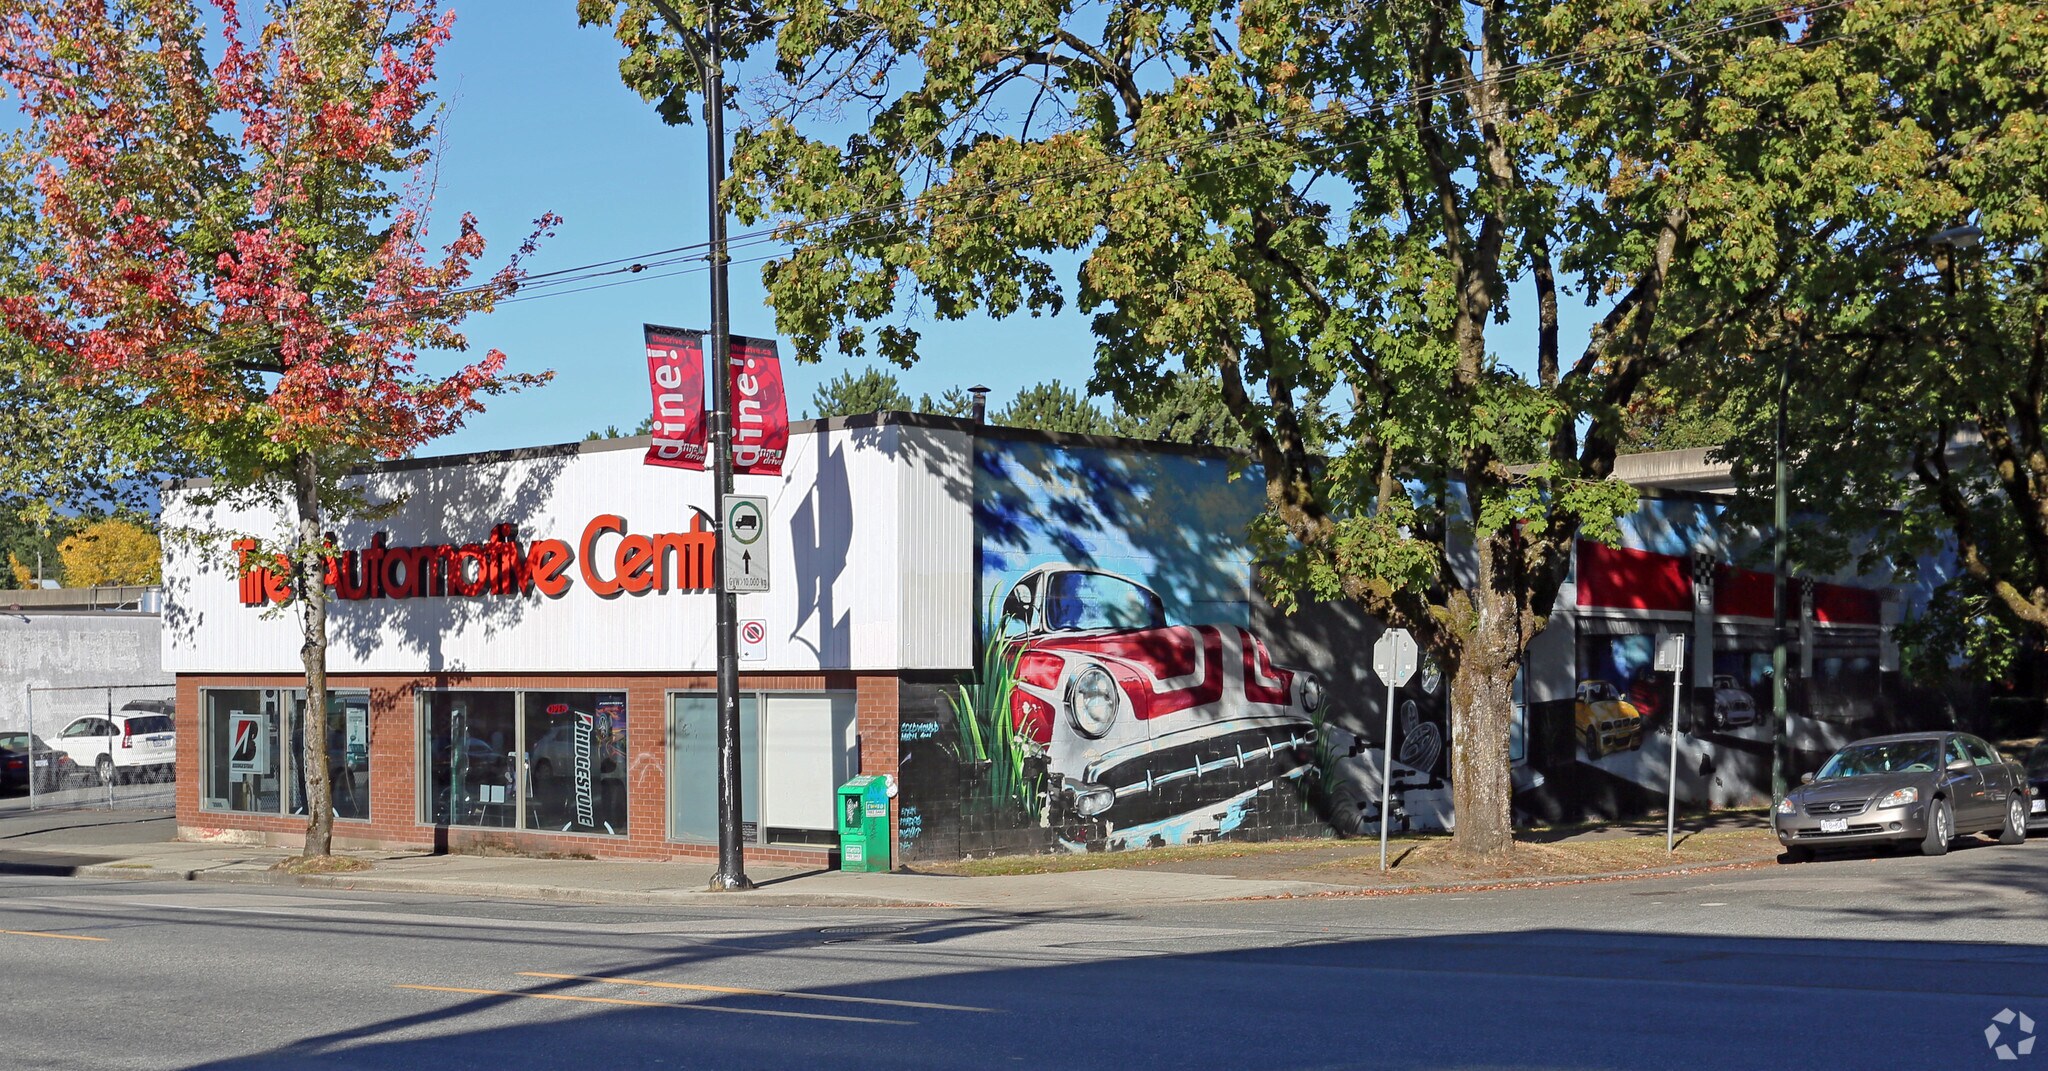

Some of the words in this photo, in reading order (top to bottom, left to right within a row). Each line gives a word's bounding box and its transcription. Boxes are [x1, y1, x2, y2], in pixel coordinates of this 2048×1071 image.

[652, 334, 695, 347] thedrive.ca
[648, 348, 686, 460] dine!
[730, 356, 763, 467] dine!
[321, 522, 574, 600] Automotive
[579, 512, 716, 596] Centr
[574, 711, 594, 827] BRIDGESTONE
